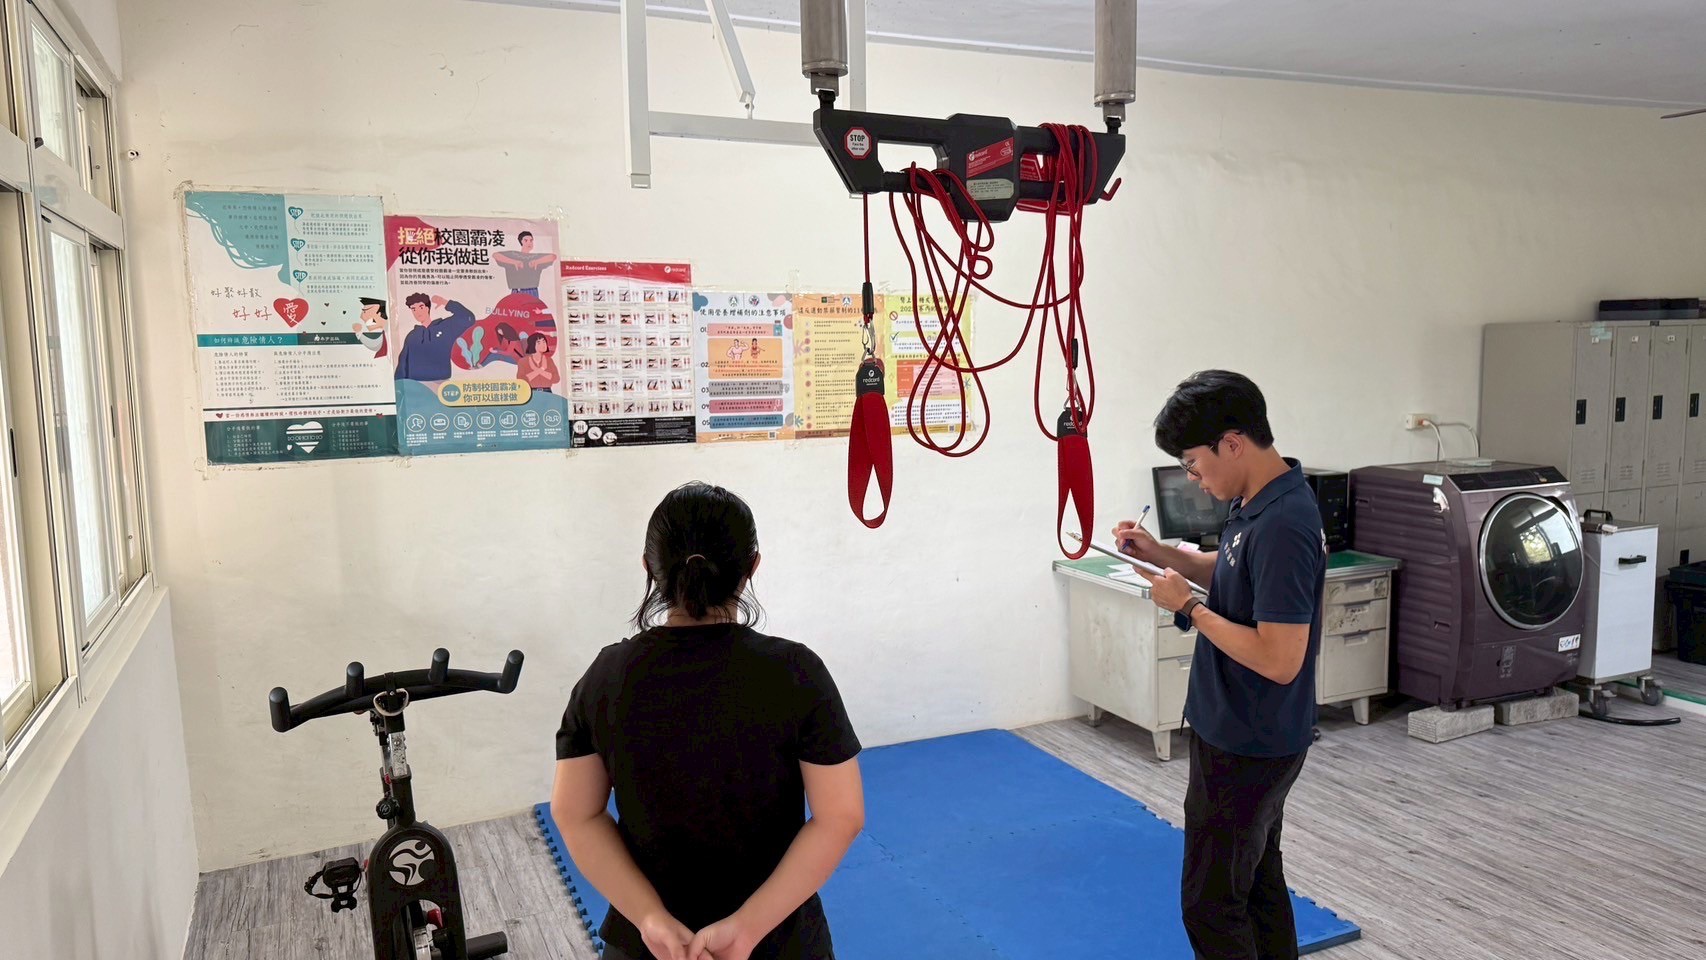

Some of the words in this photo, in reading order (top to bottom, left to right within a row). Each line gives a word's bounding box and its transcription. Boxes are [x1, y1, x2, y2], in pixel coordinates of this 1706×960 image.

[398, 226, 506, 247] 拒絕校園霸凌
[399, 246, 490, 265] 從你我做起
[210, 286, 262, 298] 好聚好散
[485, 306, 530, 318] BULLYING
[463, 393, 518, 402] 你可以這樣做
